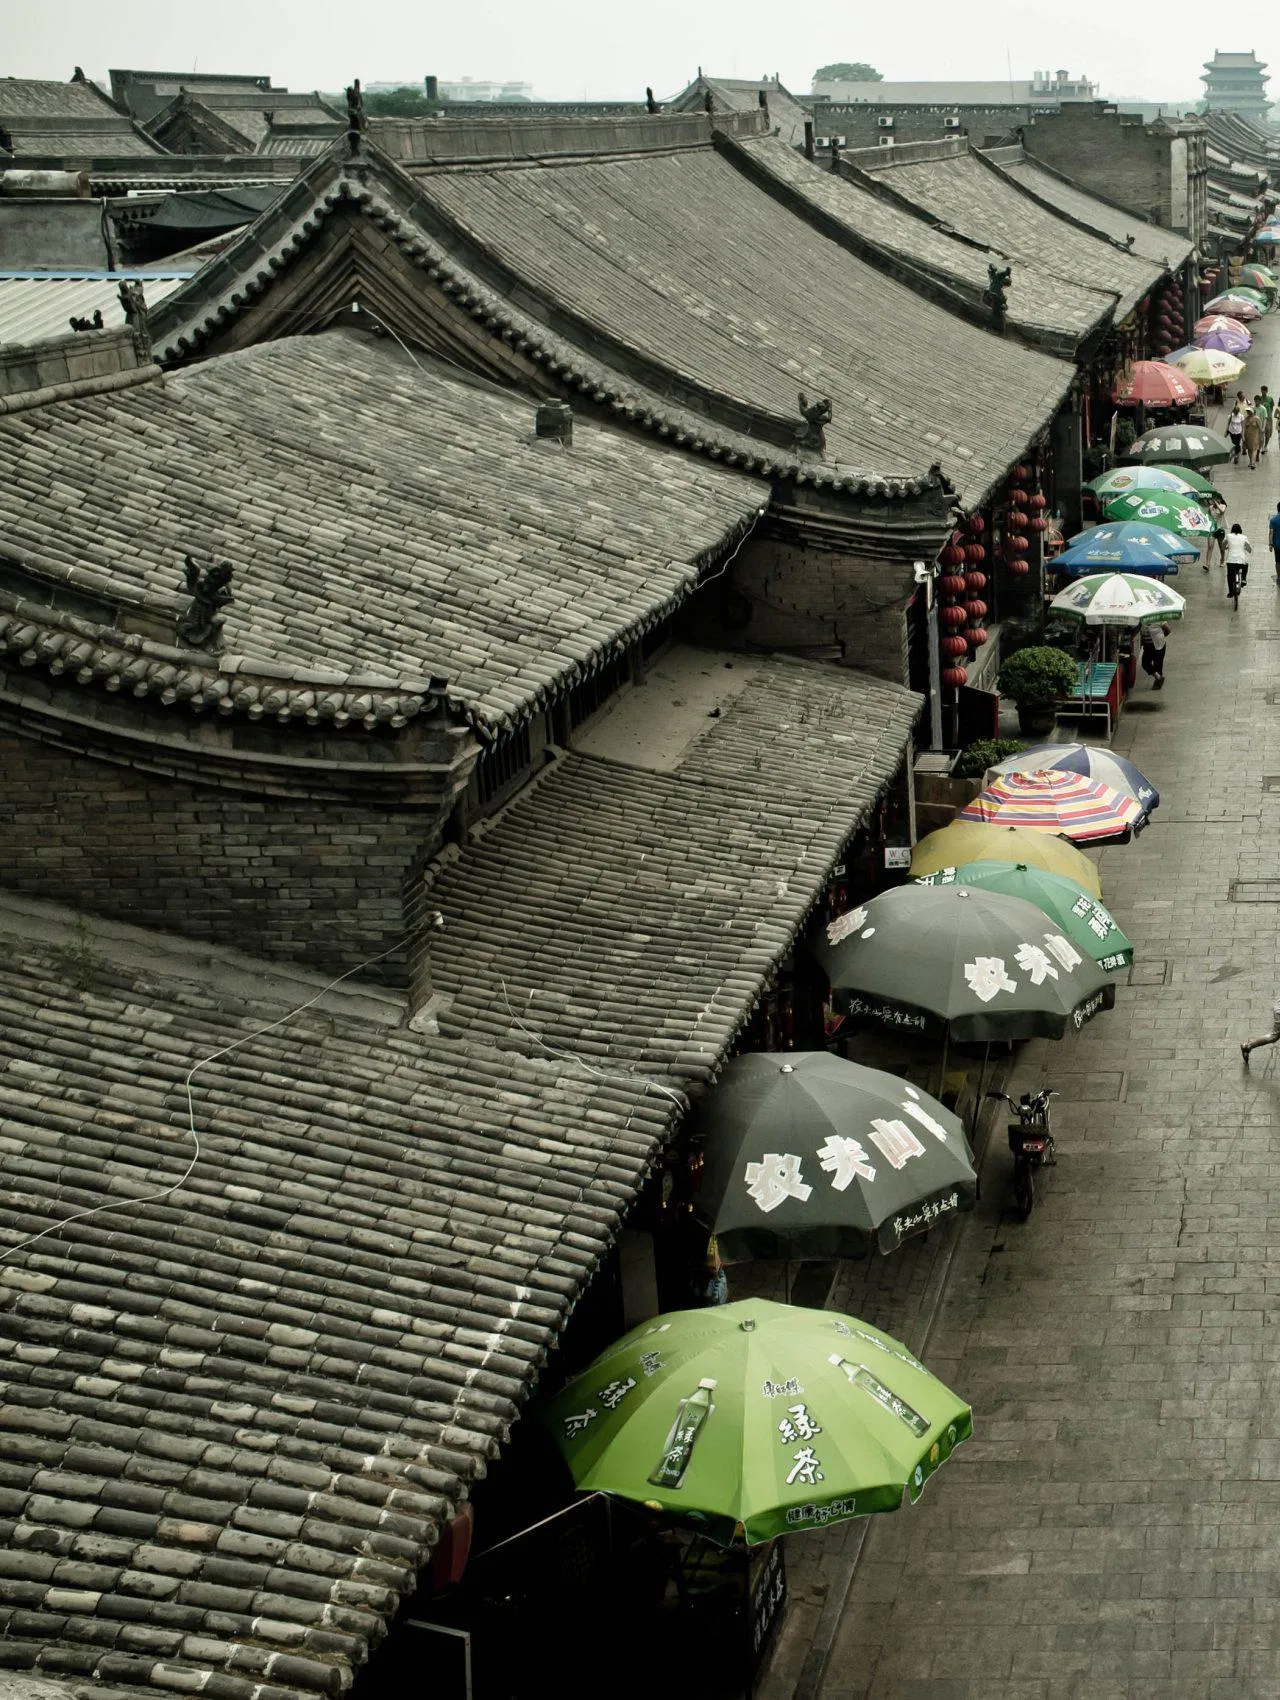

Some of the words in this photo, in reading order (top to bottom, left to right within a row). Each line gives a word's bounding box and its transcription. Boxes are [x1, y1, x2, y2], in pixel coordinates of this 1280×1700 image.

[786, 1498, 856, 1523] 健康好心情
